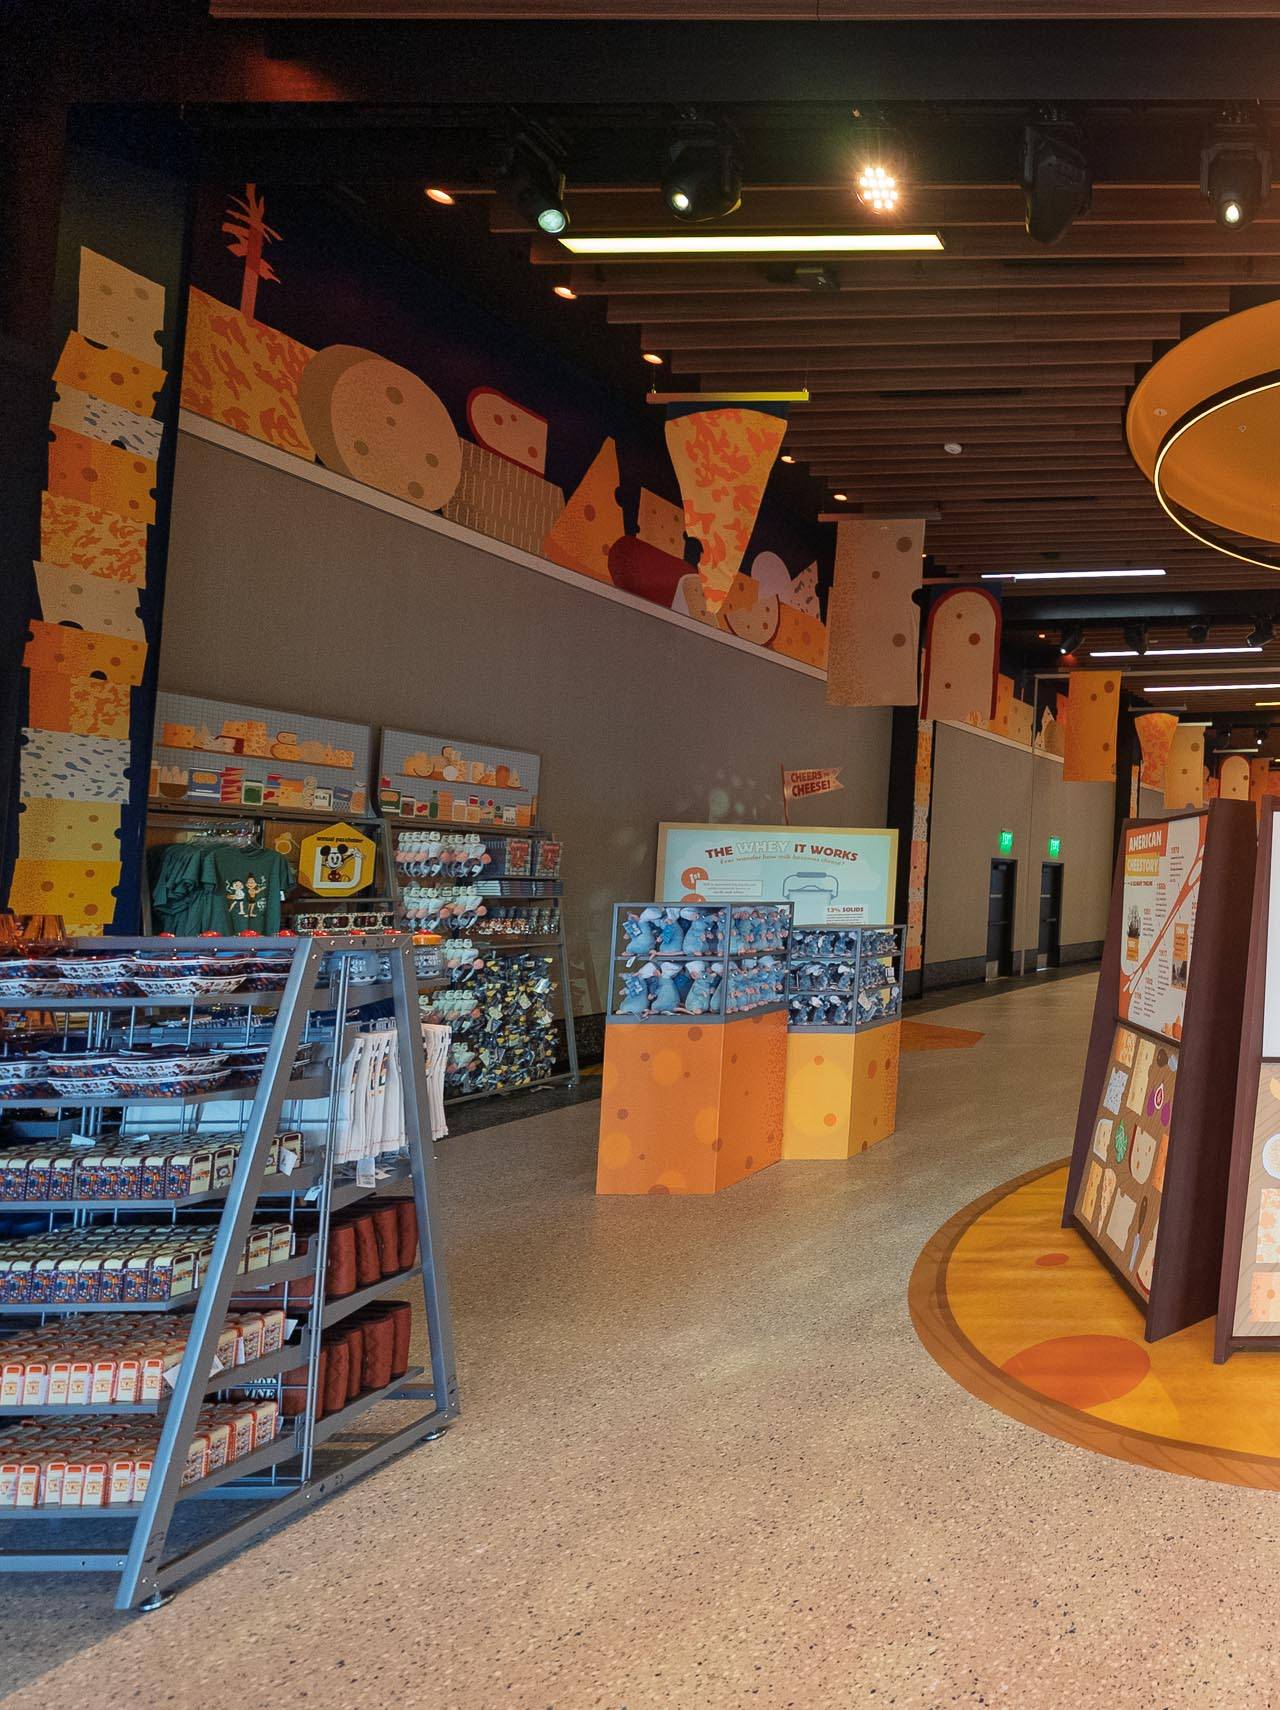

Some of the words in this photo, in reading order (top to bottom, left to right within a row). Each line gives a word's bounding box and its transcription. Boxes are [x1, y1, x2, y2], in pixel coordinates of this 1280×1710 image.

[790, 771, 822, 783] CHEERS
[792, 780, 831, 797] CHEESE!
[1128, 831, 1162, 852] AMERICAN
[705, 846, 734, 859] THE
[737, 840, 790, 854] WHEY
[794, 844, 807, 853] IT
[811, 844, 858, 862] WORKS
[1126, 857, 1158, 872] CHEESTORY
